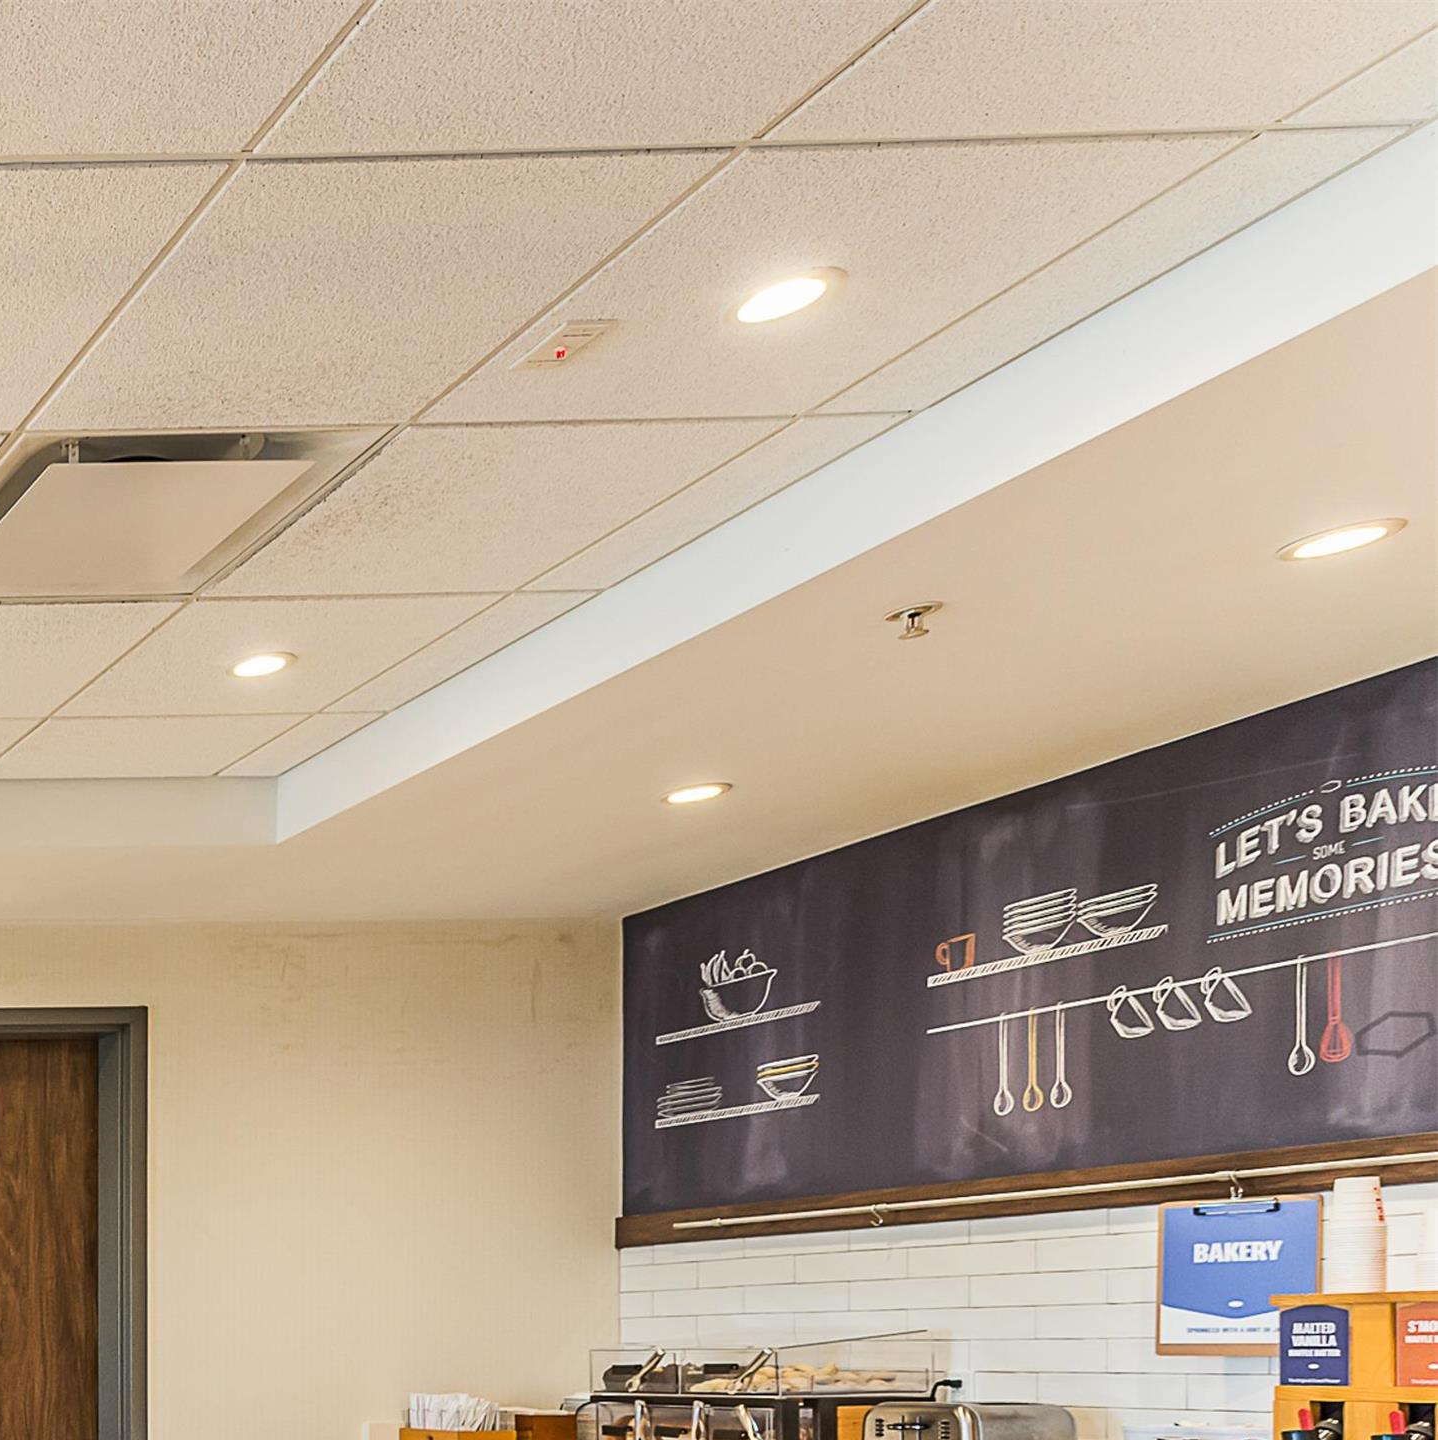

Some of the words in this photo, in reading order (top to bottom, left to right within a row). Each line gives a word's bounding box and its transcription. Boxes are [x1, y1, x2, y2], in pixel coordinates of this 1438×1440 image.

[1214, 804, 1323, 880] LET'S
[1312, 840, 1346, 860] SOME
[1216, 839, 1438, 927] MEMORIES
[1193, 1240, 1283, 1263] BAKERY
[1292, 1322, 1337, 1335] MALTED
[1291, 1335, 1338, 1347] VANILLA
